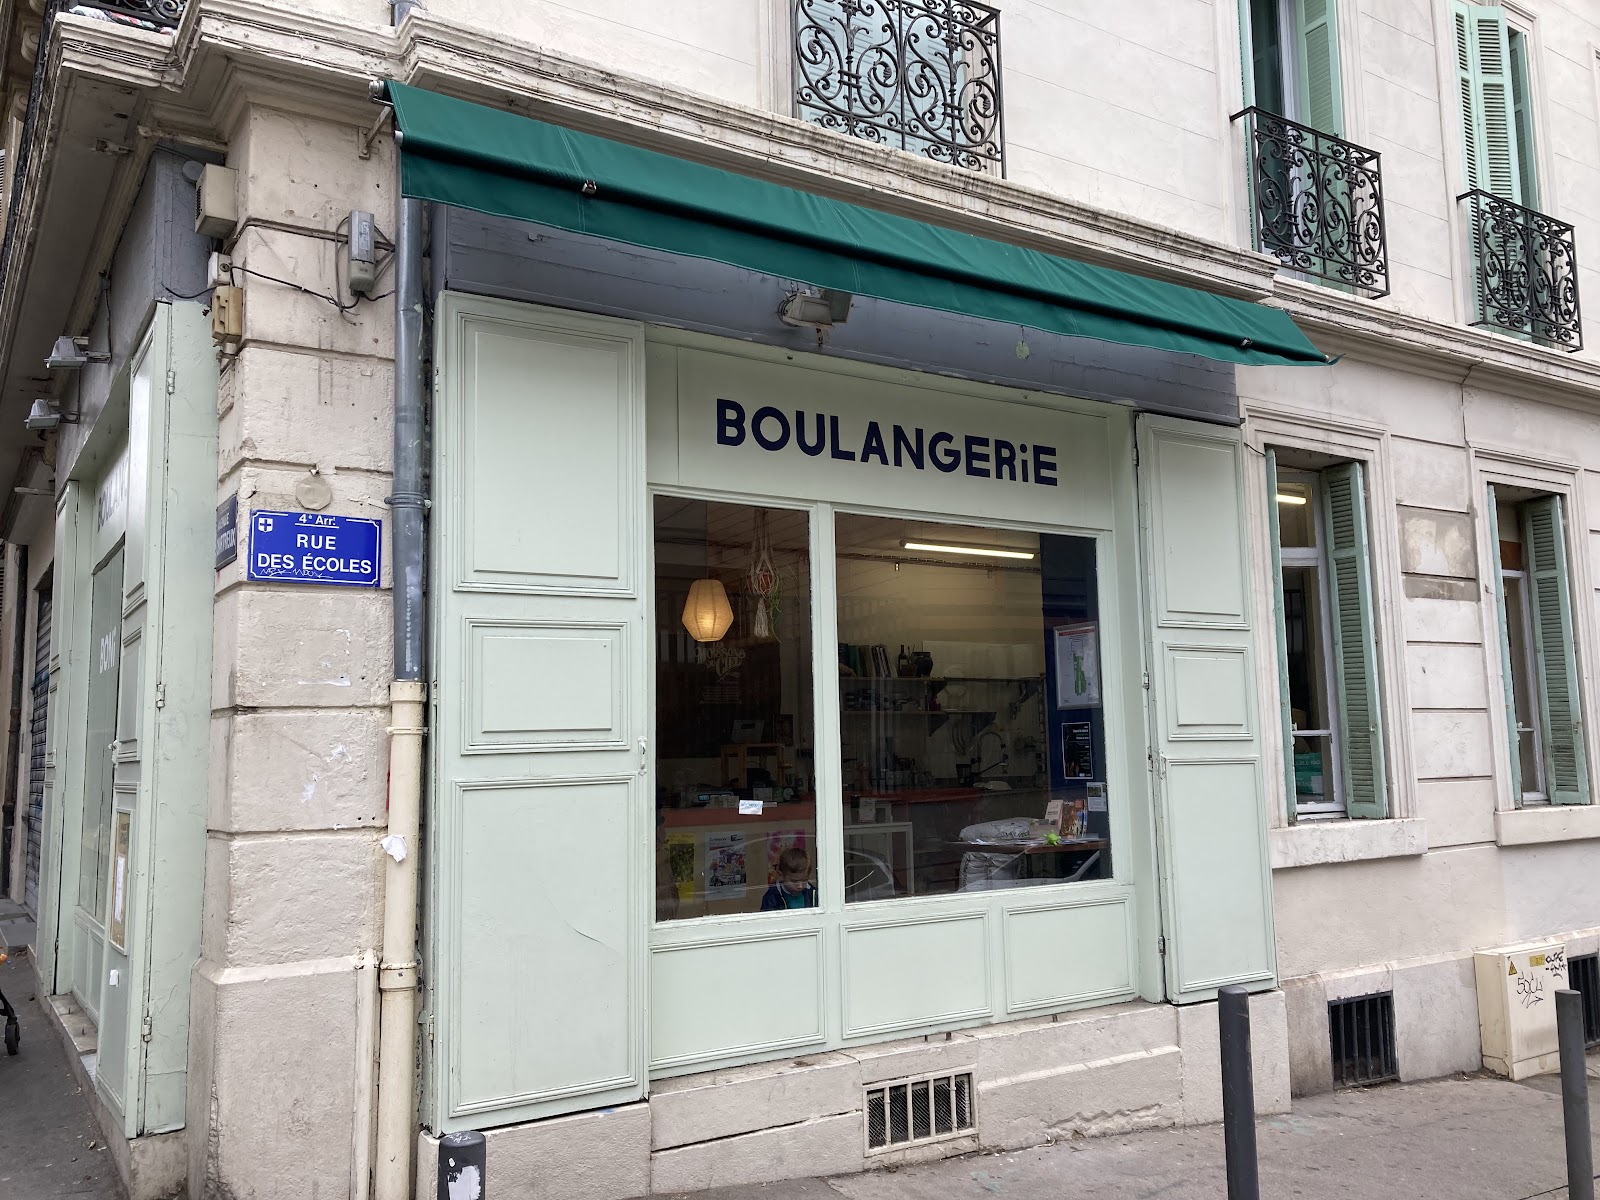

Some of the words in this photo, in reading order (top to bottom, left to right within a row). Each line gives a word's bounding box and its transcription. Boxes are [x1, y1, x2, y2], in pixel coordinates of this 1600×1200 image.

[296, 533, 337, 550] RUE
[257, 553, 294, 569] DES
[302, 553, 372, 575] ÉCOLES
